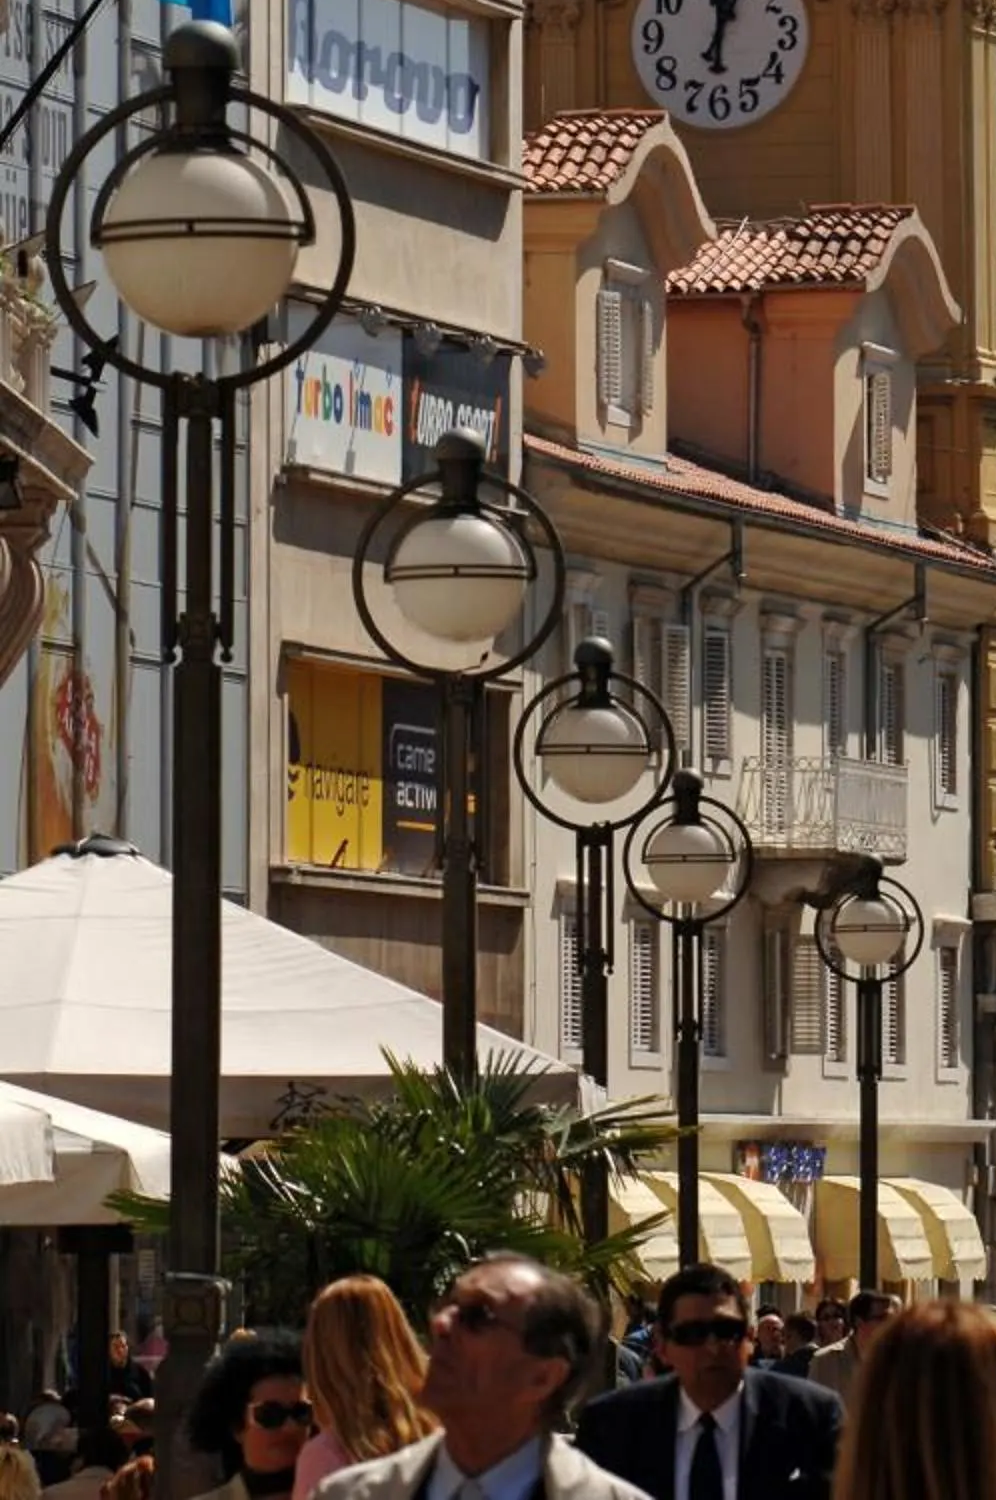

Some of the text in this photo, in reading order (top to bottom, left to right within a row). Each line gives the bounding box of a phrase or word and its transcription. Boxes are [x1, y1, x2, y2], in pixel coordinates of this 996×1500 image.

[641, 19, 665, 55] 9
[777, 15, 799, 51] 3
[655, 55, 677, 91] 8
[761, 51, 785, 85] 4
[684, 79, 706, 114] 7
[708, 84, 731, 121] 6
[738, 75, 761, 113] 5
[397, 744, 436, 774] came
